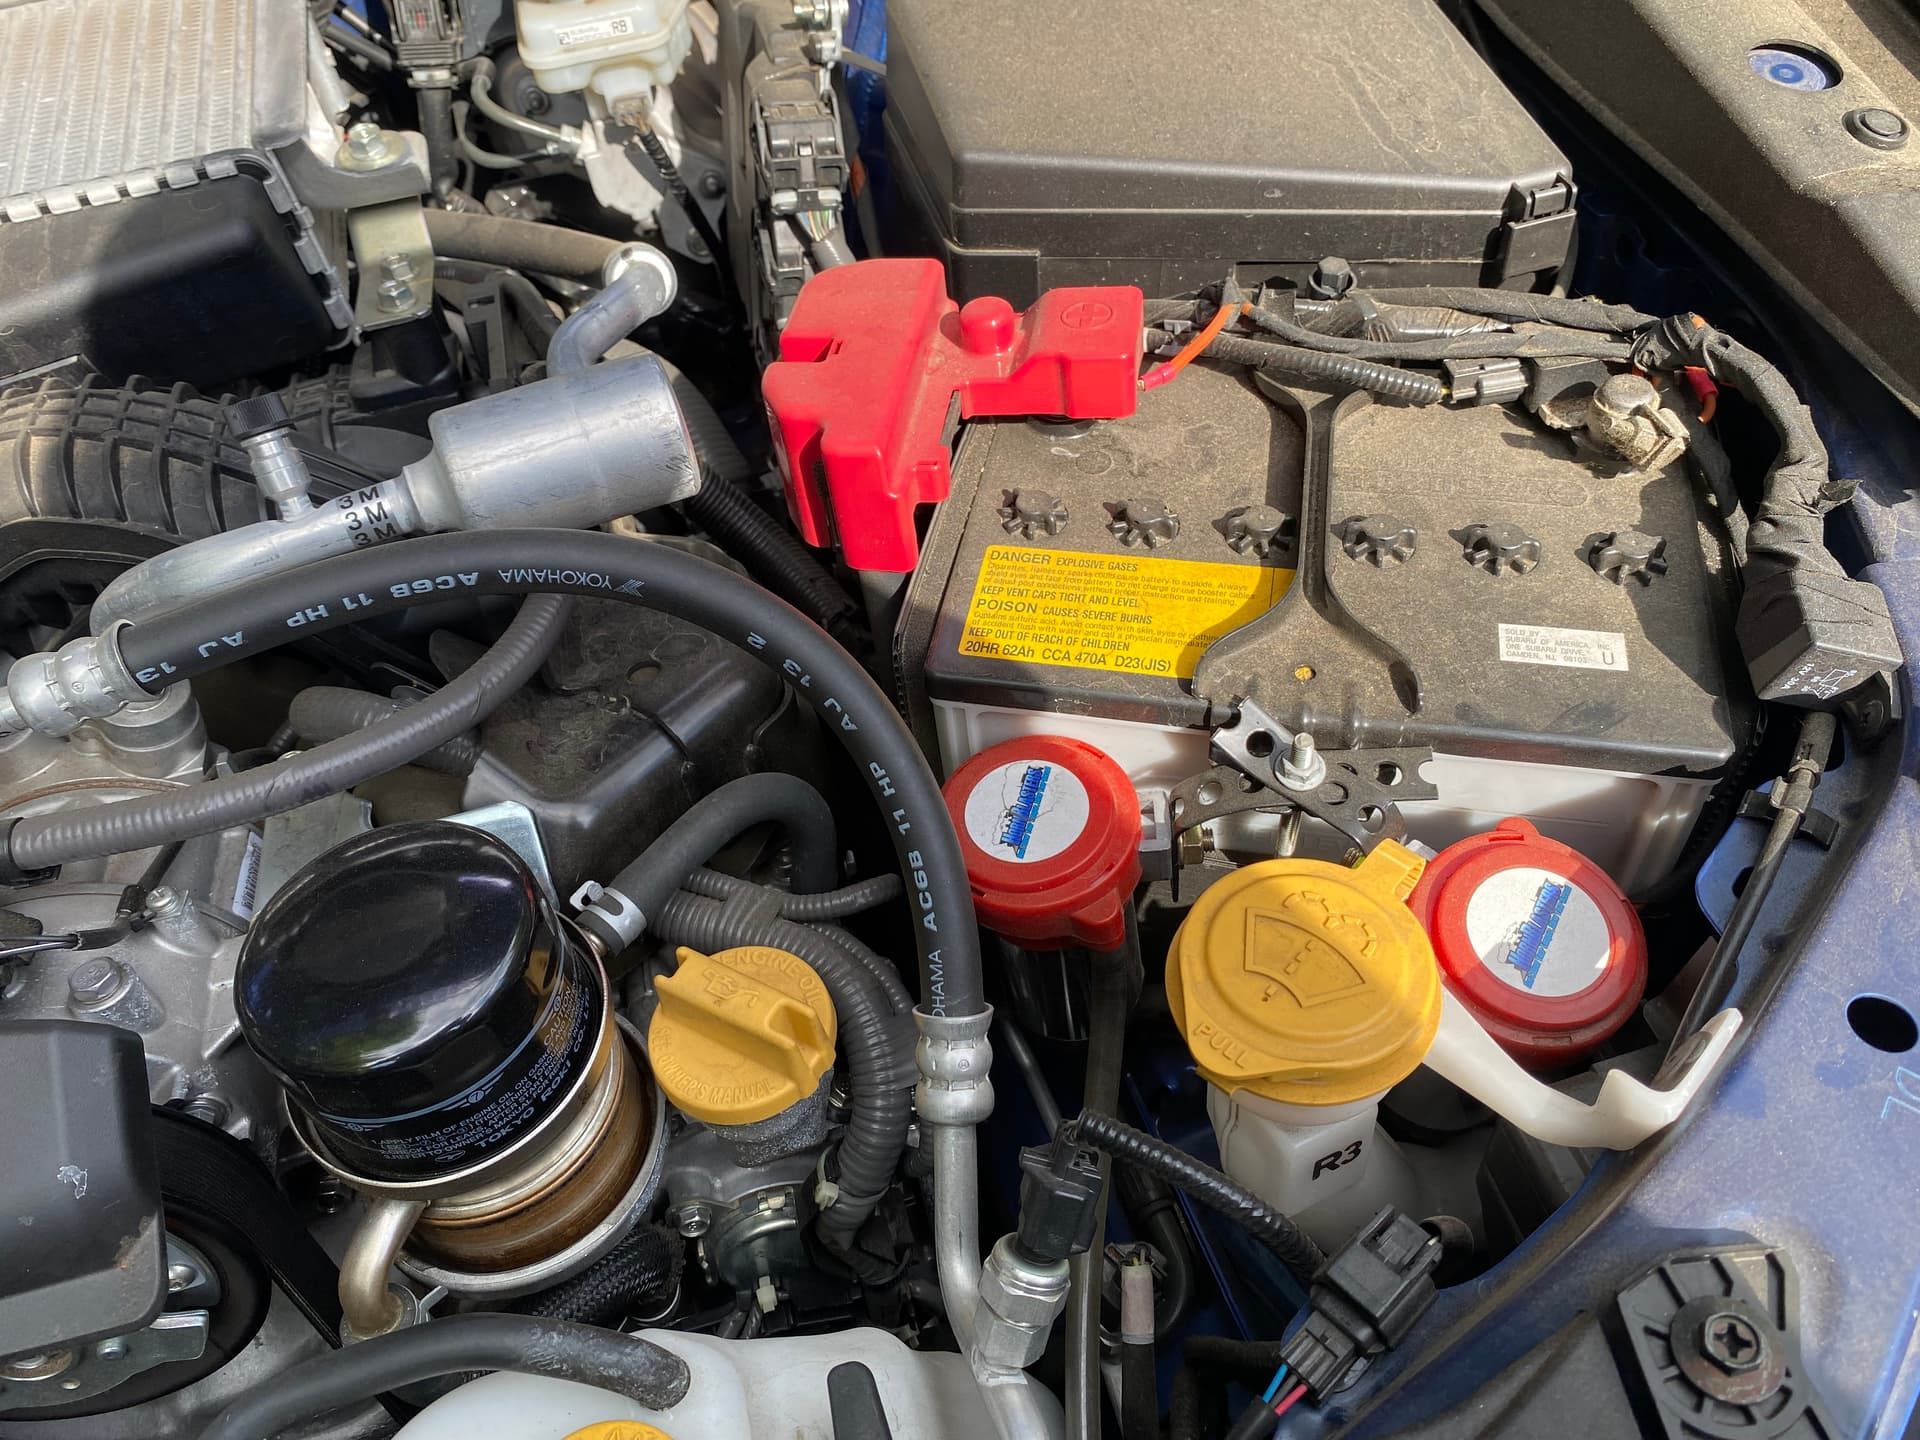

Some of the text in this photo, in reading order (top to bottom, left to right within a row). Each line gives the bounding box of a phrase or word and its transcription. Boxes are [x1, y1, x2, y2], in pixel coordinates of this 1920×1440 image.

[990, 550, 1137, 571] DANGER EXPLOSIVE GASES
[975, 598, 1152, 624] POISON CAUSES SEVERE BURNS
[980, 585, 1139, 607] KEEP VENT CAPS TIGHT AND LEVEL
[135, 569, 612, 684] YOKOHAMA AC6B 11 HP AJ 13
[746, 631, 768, 650] 2
[968, 627, 1130, 650] KEEP OUT OF REACH OF CHILDREN
[1505, 635, 1536, 644] SUBARU
[964, 640, 1172, 672] 20HR 62Ah CCA 470A D23(JIS)
[1505, 642, 1521, 650] ONE
[1525, 644, 1556, 653] SUBARU
[1602, 651, 1614, 665] U
[782, 658, 812, 688] 13
[823, 697, 859, 731] AJ
[869, 761, 896, 797] HP
[892, 808, 911, 836] 11
[908, 850, 938, 932] AC6B
[720, 949, 824, 1007] ENGINE OIL
[542, 985, 572, 1046] CAUTION
[1193, 1022, 1247, 1070] PULL
[414, 1130, 440, 1141] FILM
[442, 1123, 458, 1133] OF
[458, 1101, 497, 1127] ENGINE
[497, 1088, 513, 1104] OIL
[513, 1075, 527, 1090] ON
[526, 1041, 555, 1077] GASKET
[474, 1104, 535, 1150] TOKYO
[539, 1058, 572, 1102] ROKI
[709, 1079, 777, 1105] MANUAL
[487, 1101, 518, 1126] AFTER
[493, 1096, 532, 1129] MANUAL
[1312, 1141, 1363, 1181] R3
